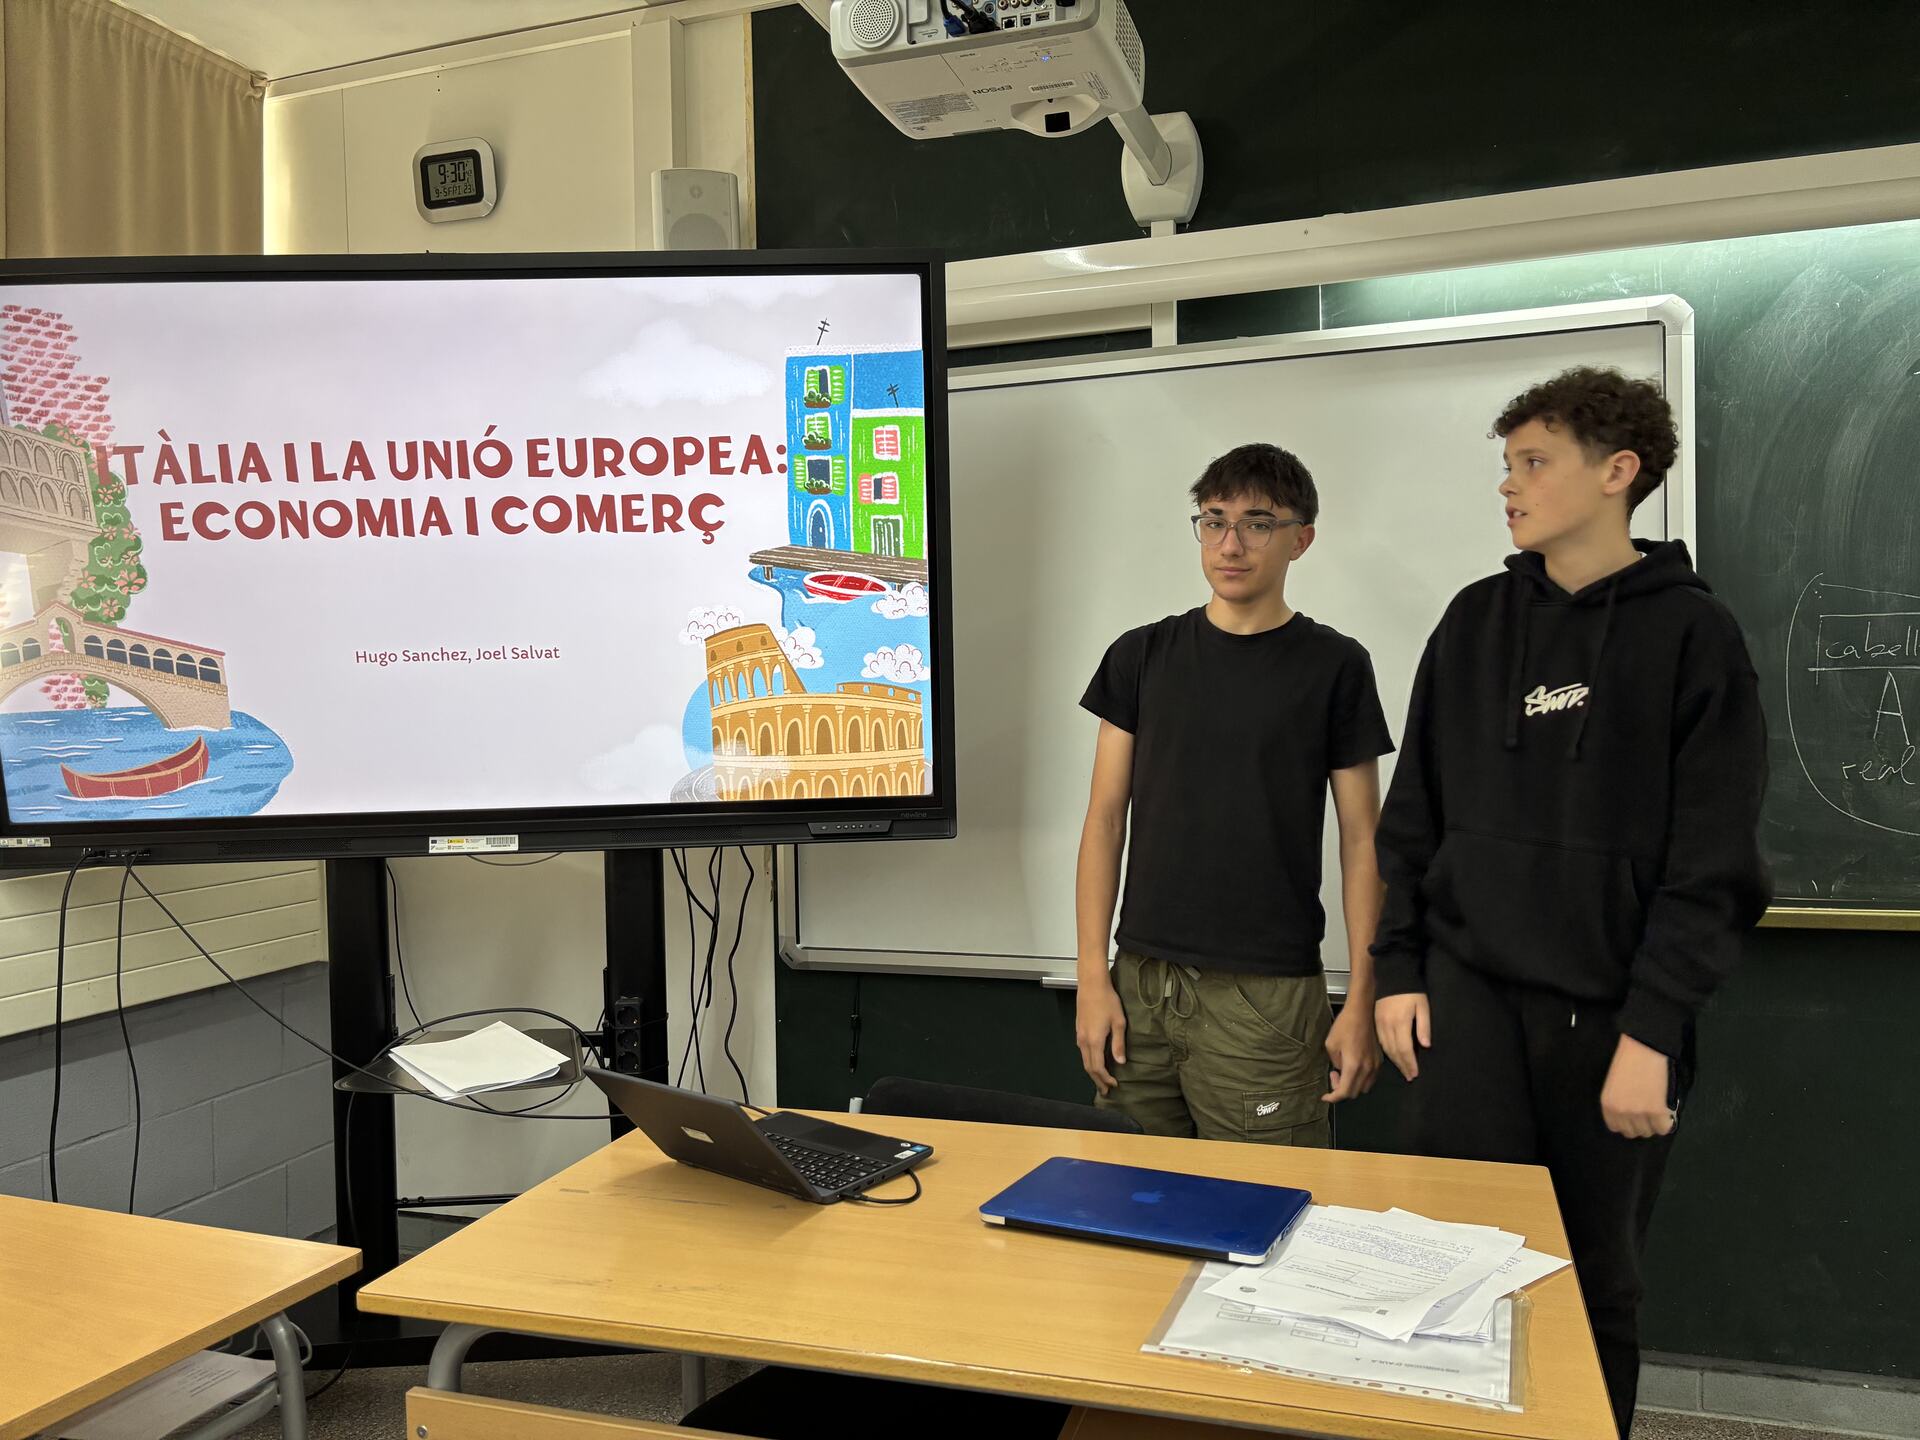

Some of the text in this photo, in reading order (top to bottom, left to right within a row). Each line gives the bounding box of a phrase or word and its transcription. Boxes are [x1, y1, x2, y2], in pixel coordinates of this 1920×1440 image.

[972, 84, 1013, 95] EPSON
[438, 161, 466, 185] 9:30
[96, 425, 788, 486] ITÀLIA I LA UNIÓ EUROPEA:
[160, 493, 725, 545] ECONOMIA I COMERÇ
[355, 645, 560, 667] Hugo Sanchez, Joel Salvat
[1825, 621, 1920, 659] cabell
[1873, 671, 1910, 746] A
